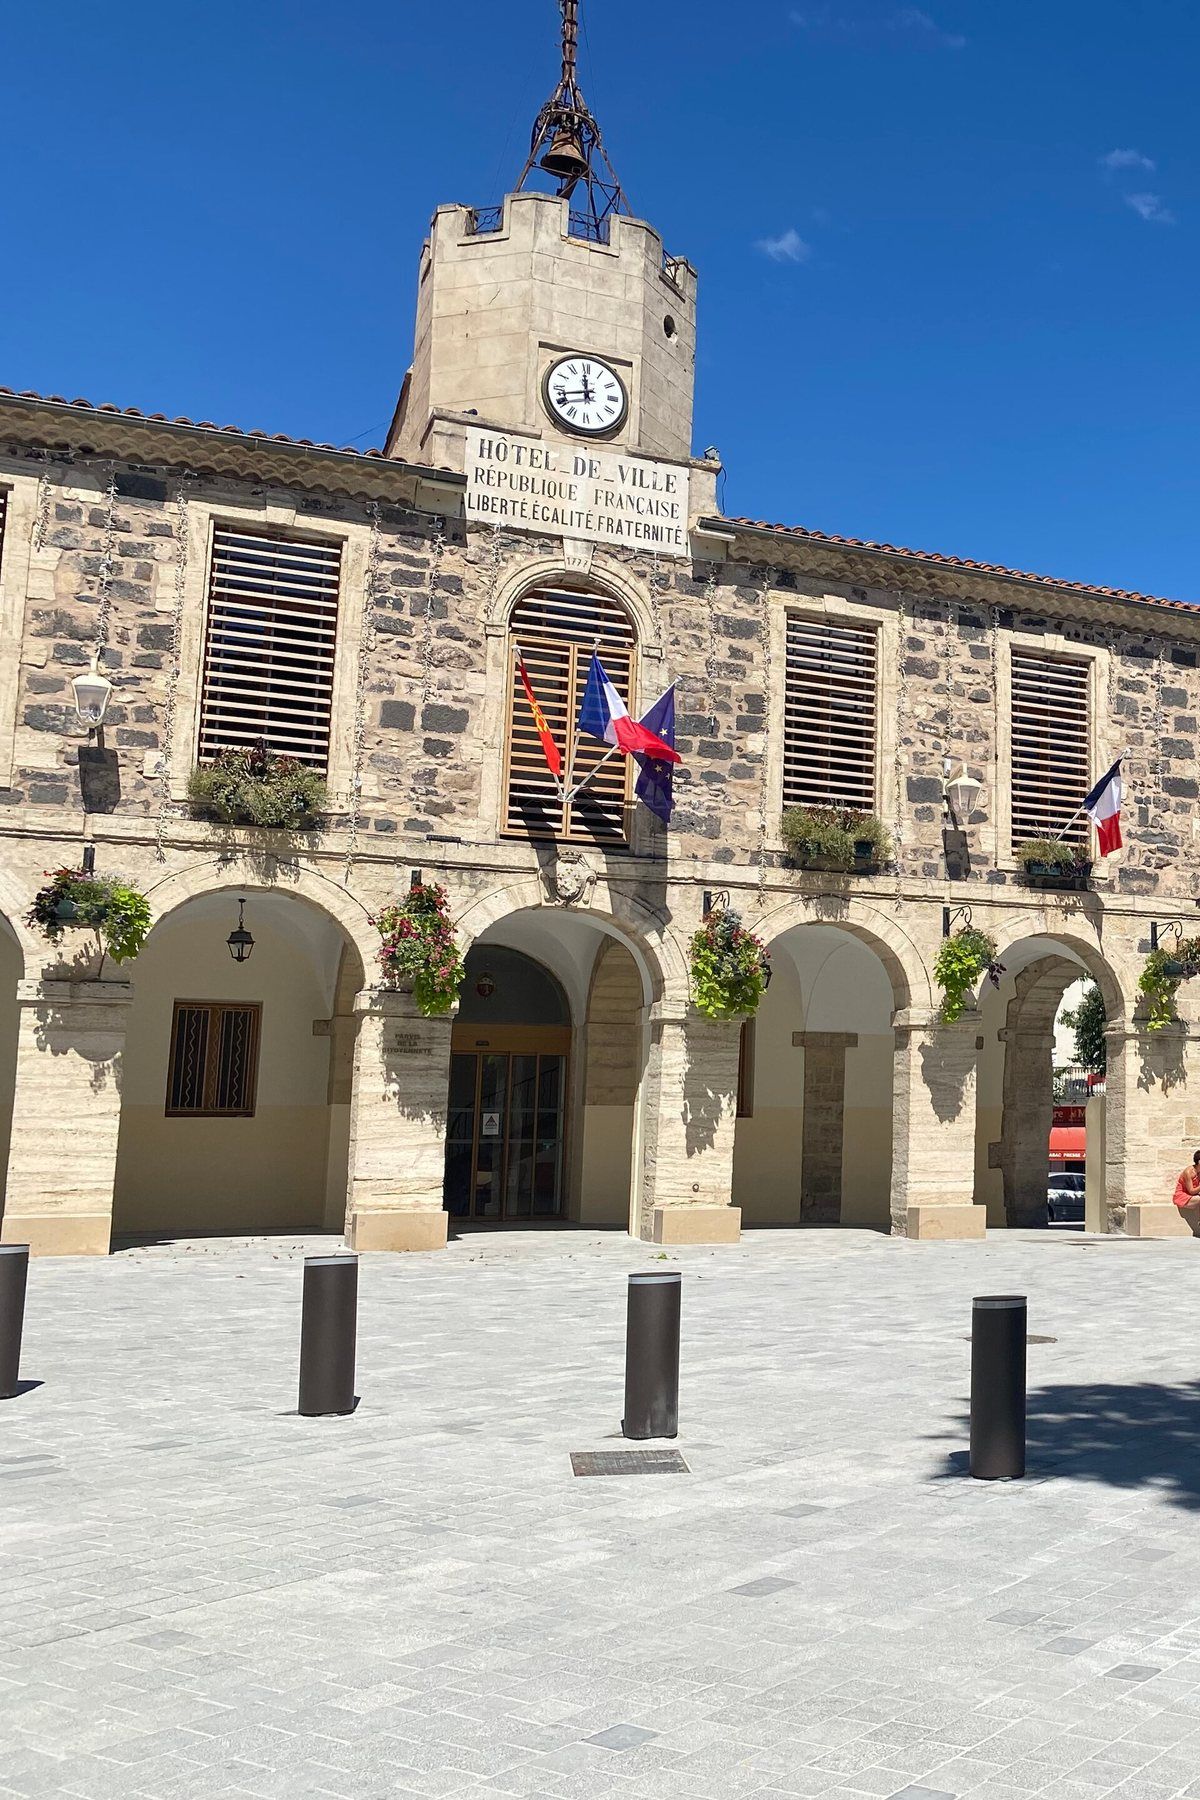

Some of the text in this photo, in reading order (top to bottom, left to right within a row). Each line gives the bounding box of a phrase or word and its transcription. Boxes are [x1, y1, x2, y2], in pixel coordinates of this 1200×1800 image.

[474, 464, 680, 520] RÉPUBLIQUE FRANÇAISE
[478, 436, 677, 494] HÔTEL DE VILLE
